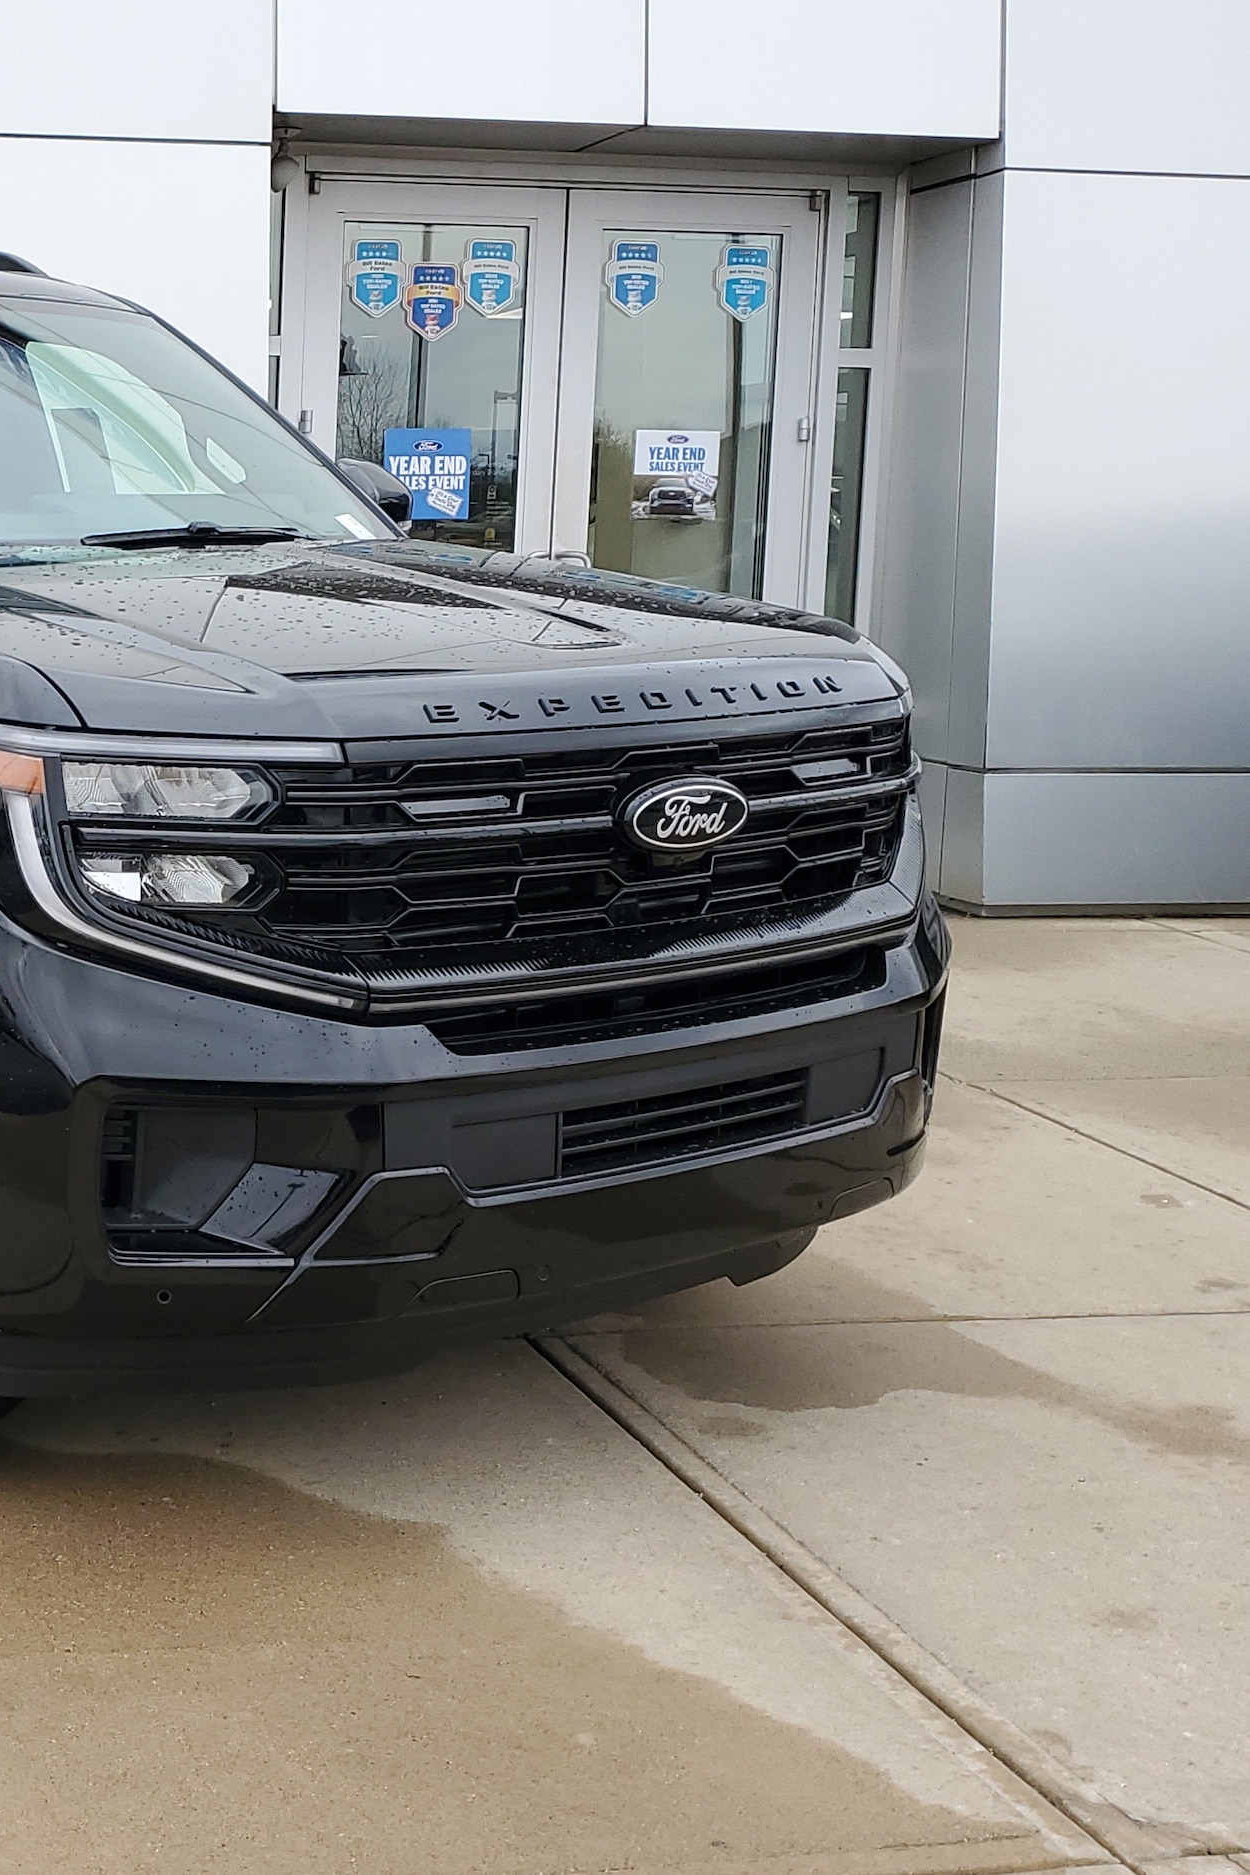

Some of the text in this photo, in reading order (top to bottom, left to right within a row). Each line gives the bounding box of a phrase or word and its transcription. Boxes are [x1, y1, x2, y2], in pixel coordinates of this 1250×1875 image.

[417, 441, 440, 451] Ford
[649, 446, 706, 461] YEAR END
[388, 455, 467, 475] YEAR END
[649, 461, 704, 472] SALES EVENT
[398, 475, 466, 491] ALES EVENT
[422, 674, 843, 724] EXPEDITION
[656, 794, 728, 838] Ford
